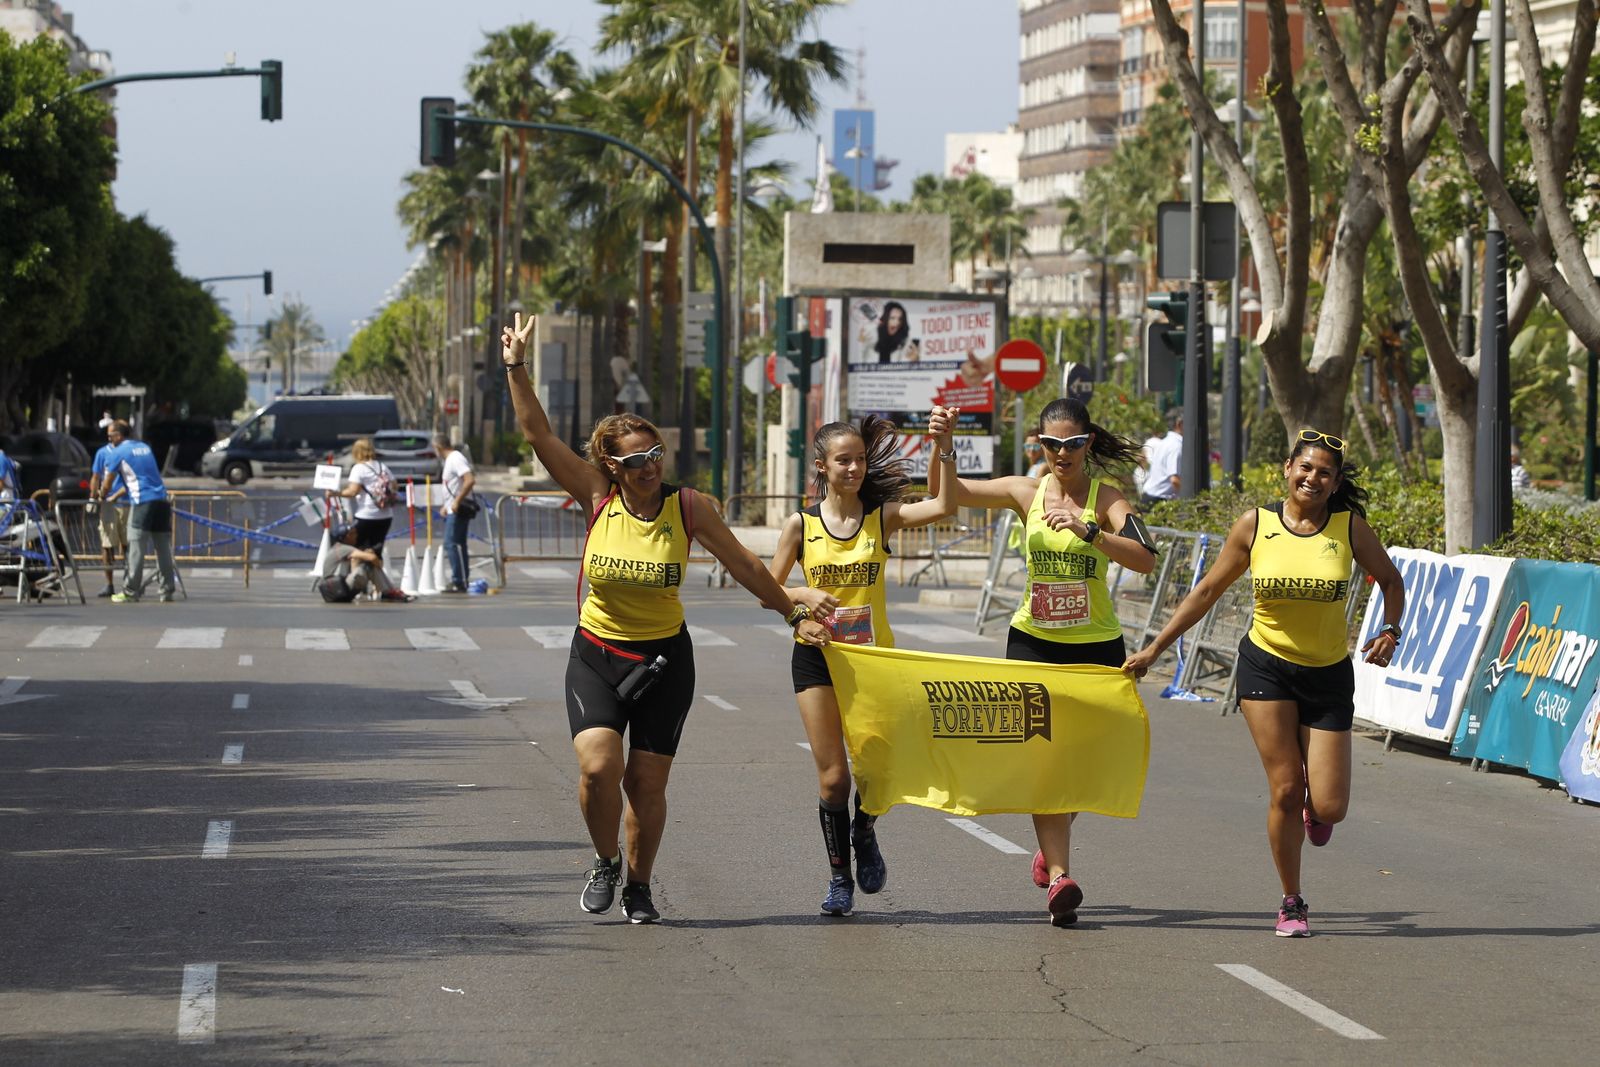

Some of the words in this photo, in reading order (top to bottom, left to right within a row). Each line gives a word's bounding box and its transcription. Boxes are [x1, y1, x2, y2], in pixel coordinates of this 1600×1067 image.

[921, 316, 952, 335] TODO
[957, 312, 991, 331] TIENE
[590, 553, 665, 574] RUNNERS
[810, 562, 868, 578] RUNNERS
[589, 564, 665, 585] FOREVER
[668, 564, 679, 585] TEAM
[1254, 577, 1336, 592] RUNNERS
[1046, 594, 1087, 611] 1265
[1515, 605, 1599, 698] cajamar
[921, 681, 1024, 703] RUNNERS
[1028, 684, 1045, 731] TEAM
[930, 704, 1024, 733] FOREVER
